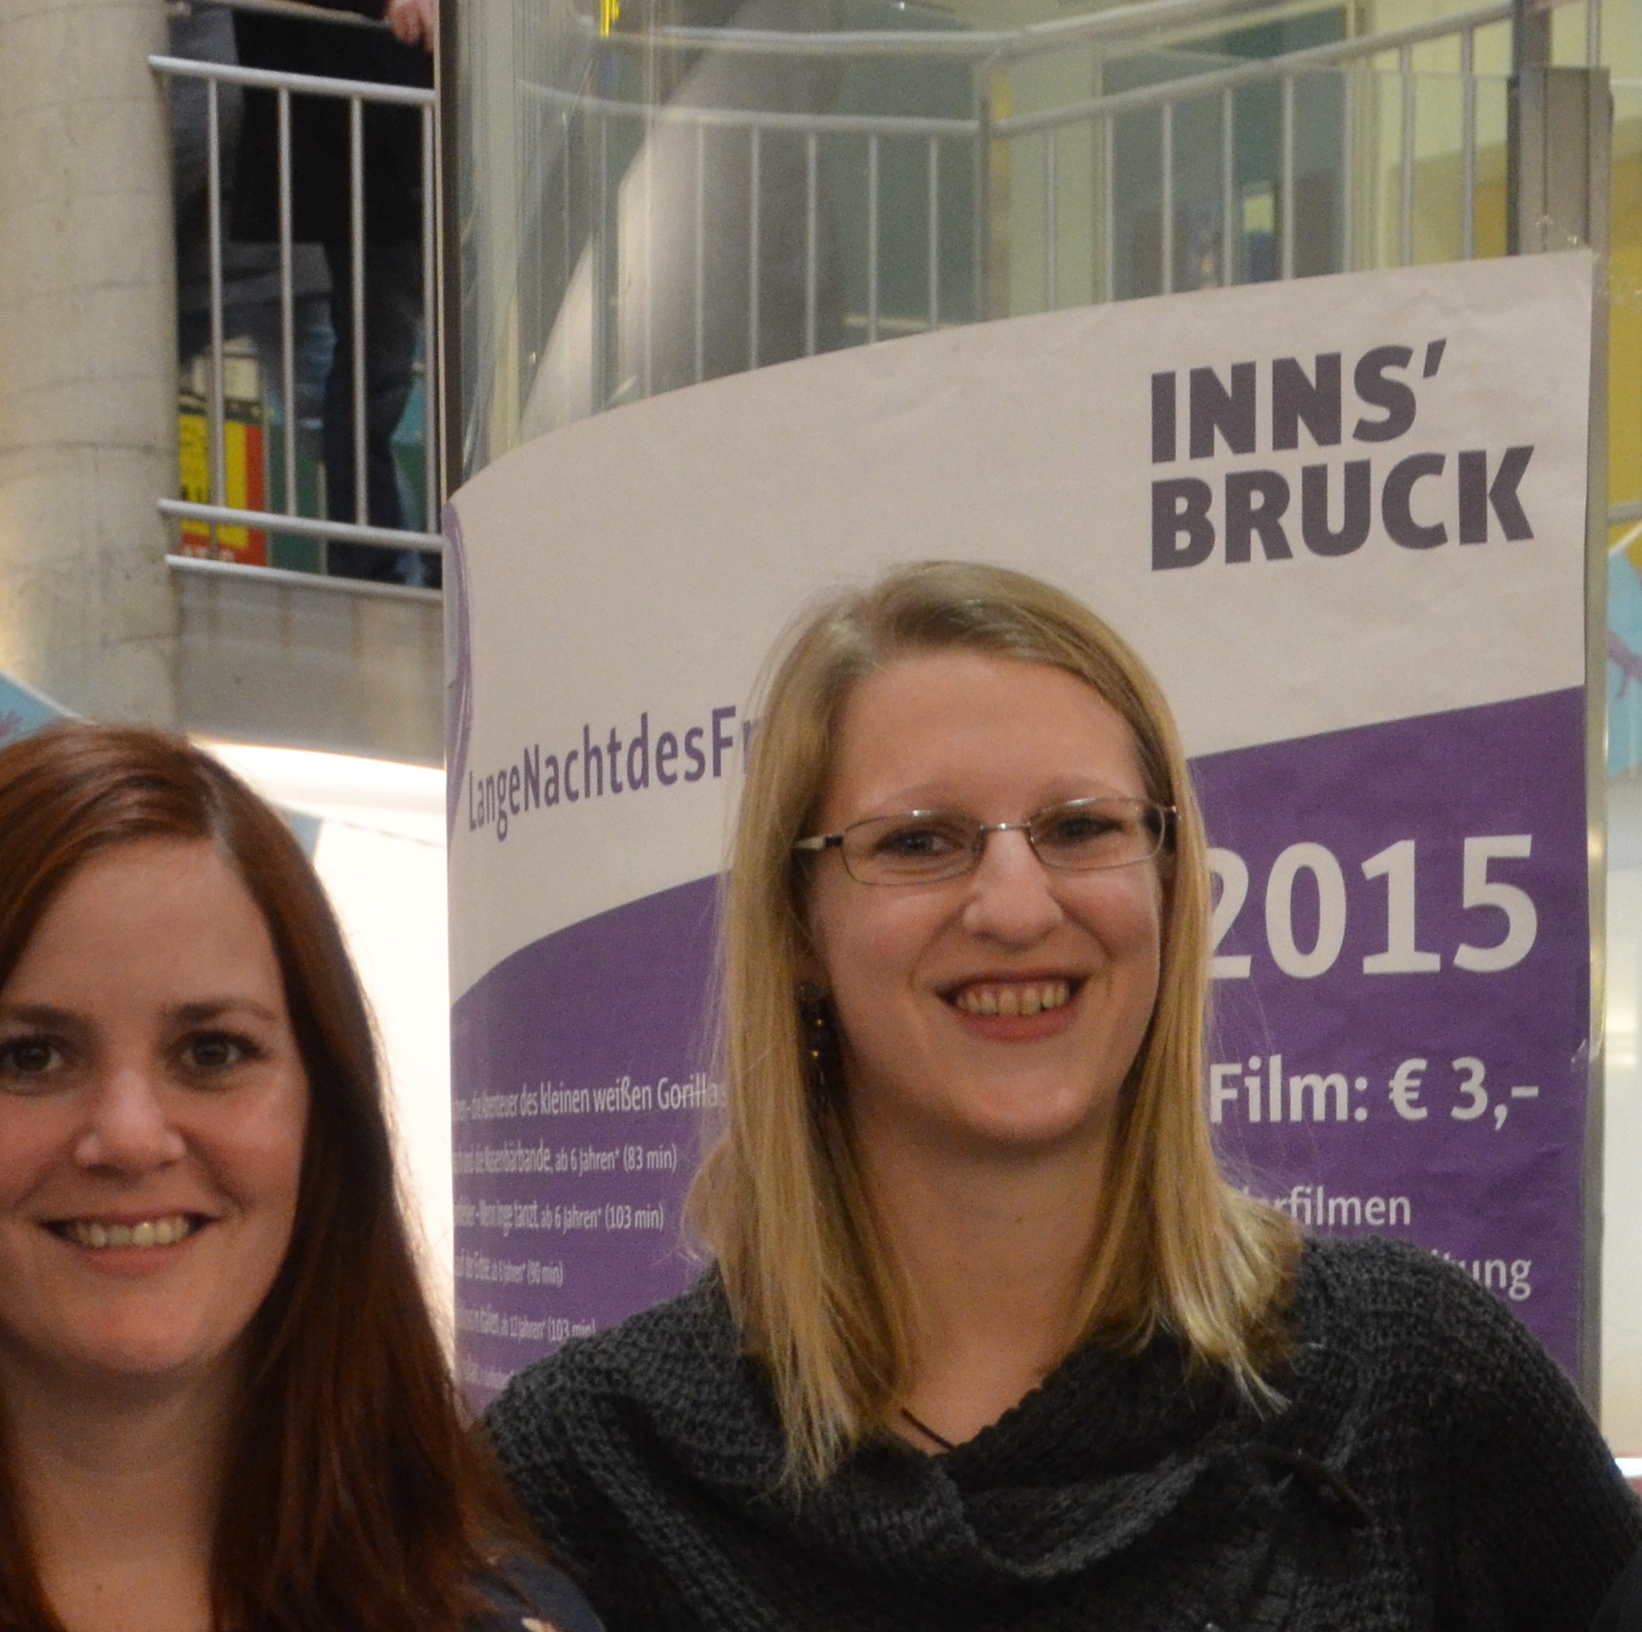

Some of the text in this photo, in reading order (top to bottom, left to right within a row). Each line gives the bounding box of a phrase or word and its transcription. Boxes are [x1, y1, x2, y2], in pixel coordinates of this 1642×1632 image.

[1151, 338, 1447, 464] INNS'
[1151, 445, 1535, 572] BRUCK
[469, 705, 759, 842] LangeNachtdesFr
[1207, 834, 1538, 979] 2015
[519, 1084, 539, 1116] des
[540, 1079, 590, 1114] kleinen
[593, 1076, 652, 1112] weißen
[1209, 1054, 1369, 1124] Film:
[1388, 1058, 1429, 1121] €
[570, 1149, 578, 1171] 6
[623, 1145, 644, 1172] (83
[647, 1143, 677, 1176] min)
[606, 1203, 632, 1232] (103
[635, 1203, 664, 1232] min)
